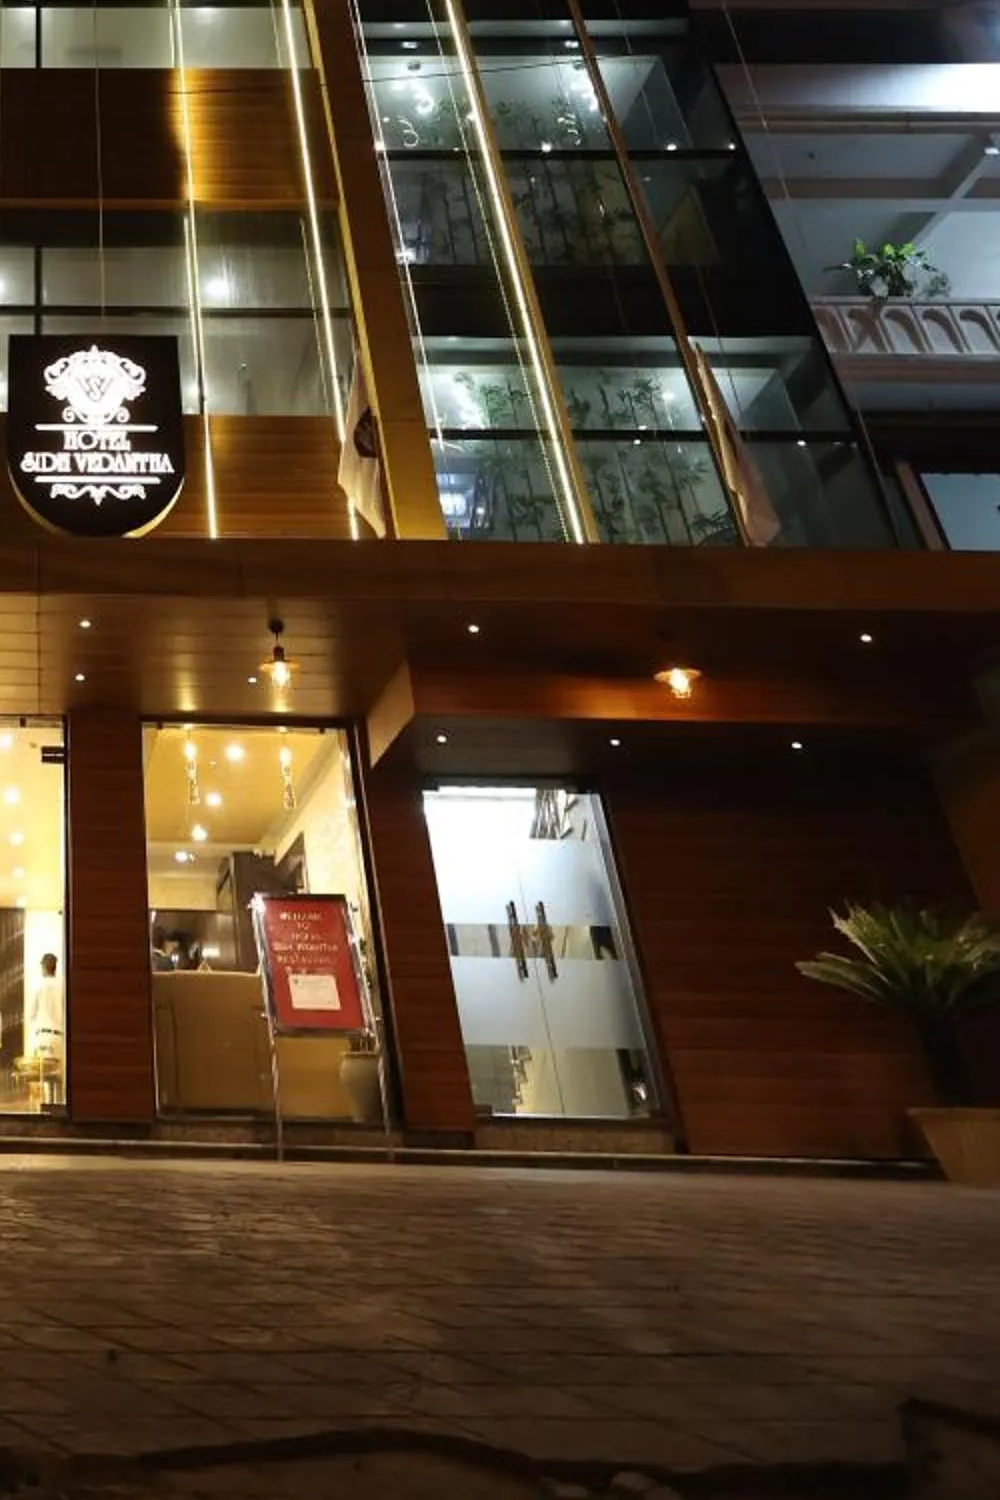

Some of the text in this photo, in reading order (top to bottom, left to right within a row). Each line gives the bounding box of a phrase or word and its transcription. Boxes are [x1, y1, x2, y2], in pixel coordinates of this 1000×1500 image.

[63, 430, 132, 452] HOTEL
[19, 451, 176, 474] SIDH VEDANTHA
